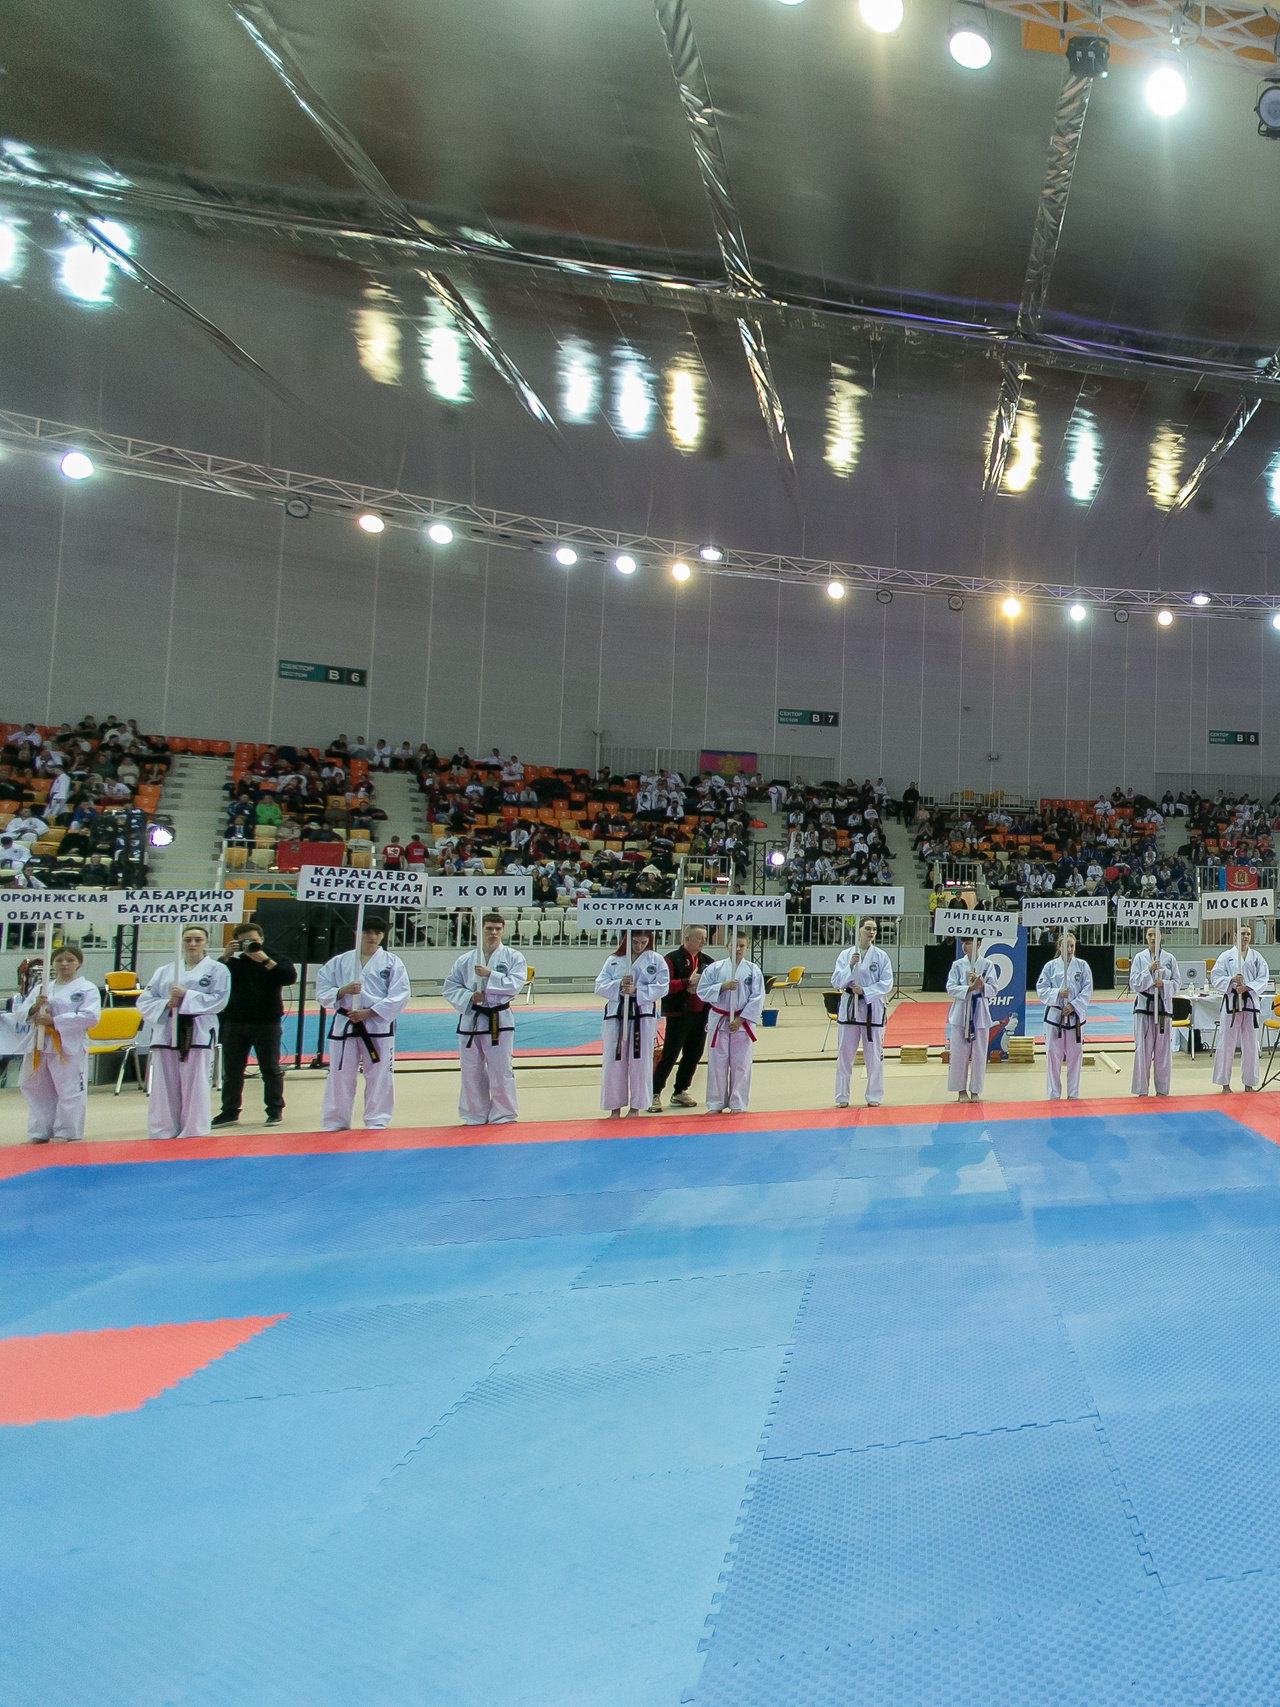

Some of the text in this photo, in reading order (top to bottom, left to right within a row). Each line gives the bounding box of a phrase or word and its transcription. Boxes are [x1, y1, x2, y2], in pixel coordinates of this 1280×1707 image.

[280, 663, 315, 672] СЕКТОР
[351, 672, 360, 682] 6
[828, 715, 834, 723] 7
[314, 866, 419, 881] КАРАЧАЕВО
[310, 877, 423, 893] ЧЕРКЕССКАЯ
[125, 890, 235, 901] КАБАРДИНО
[432, 886, 527, 897] Р. КОМИ
[0, 893, 108, 903] ОРОНЕЖСКАЯ
[305, 890, 422, 905] РЕСПУБЛИКА
[836, 893, 896, 905] КРЫМ
[582, 903, 679, 911] КОСТРОМСКАЯ
[689, 898, 782, 908] КРАСНОЯРСКИЙ
[1024, 899, 1107, 909] ЛЕНИНГРАДСКАЯ
[1123, 900, 1194, 910] ЛУГАНСКАЯ
[1206, 897, 1269, 910] МОСКВА
[118, 903, 234, 914] БАЛКАРСКАЯ
[7, 911, 85, 920] ОБЛАСТЬ
[132, 914, 229, 923] РЕСПУБЛИКА
[716, 911, 754, 922] КРАЙ
[943, 912, 1010, 923] ЛИПЕЦКАЯ
[1125, 909, 1189, 919] НАРОДНАЯ
[595, 918, 662, 926] ОБЛАСТЬ
[1042, 916, 1090, 924] ОБЛАСТЬ
[1128, 919, 1191, 927] РЕСПУБЛИКА
[947, 926, 1003, 937] ОБЛАСТЬ
[986, 996, 1014, 1006] ЯНГ
